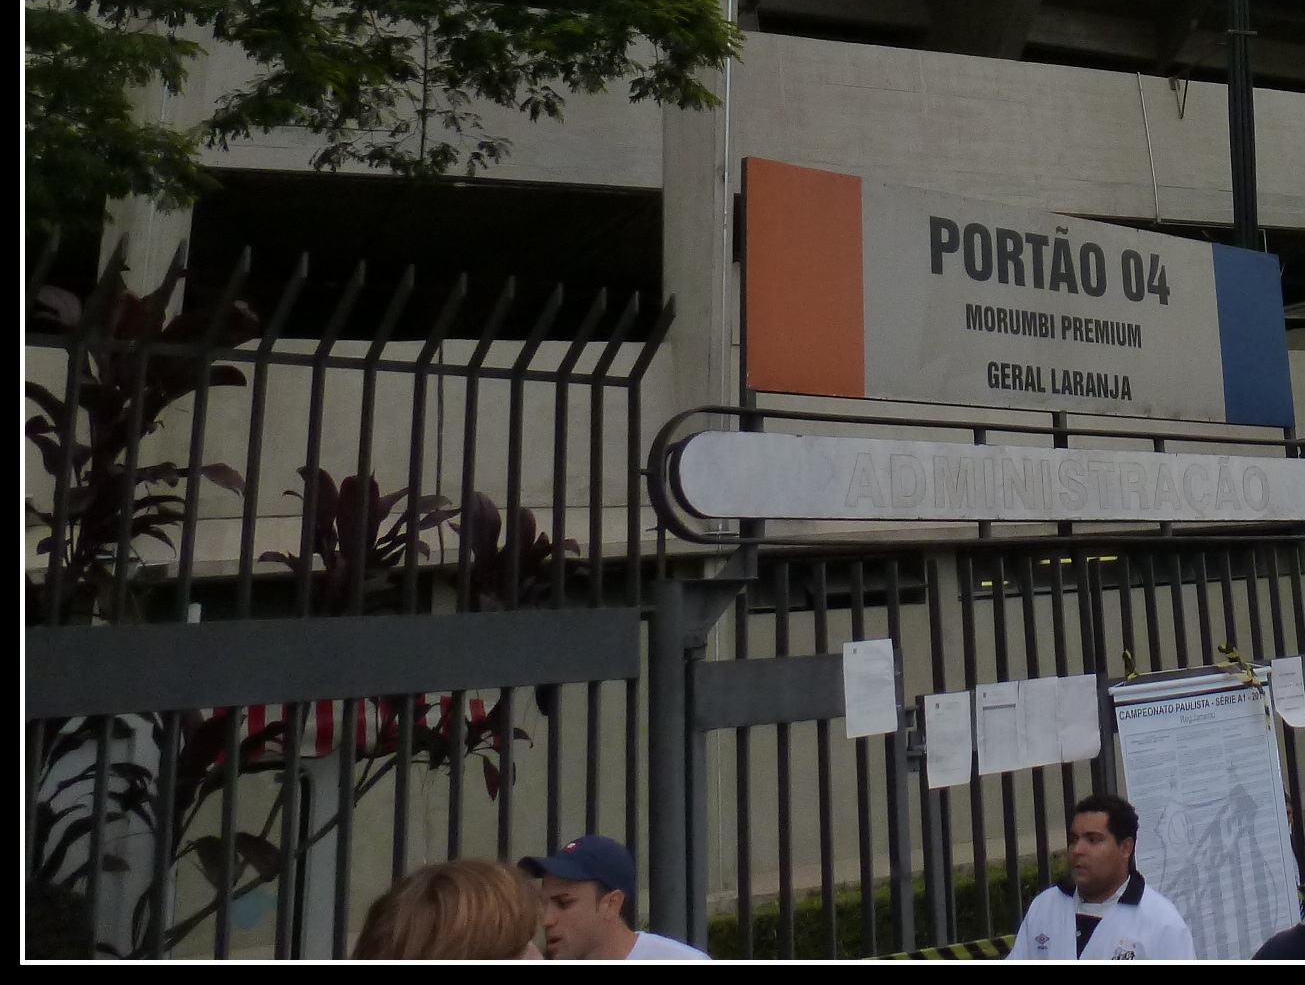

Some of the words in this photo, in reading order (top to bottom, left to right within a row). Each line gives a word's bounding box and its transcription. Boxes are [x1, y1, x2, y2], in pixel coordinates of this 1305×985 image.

[930, 216, 1107, 298] PORTÃO
[1121, 248, 1170, 305] 04
[966, 303, 1055, 339] MORUMBI
[1061, 315, 1142, 348] PREMIUM
[987, 361, 1046, 393] GERAL
[1051, 368, 1132, 401] LARANJA
[844, 453, 1271, 513] ADMINISTRAÇÃO
[1119, 704, 1174, 721] CAMPEONATO
[1175, 700, 1211, 713] PAULISTA
[1215, 693, 1236, 706] SÉRIE
[1237, 693, 1247, 703] A1
[1251, 691, 1264, 701] 201
